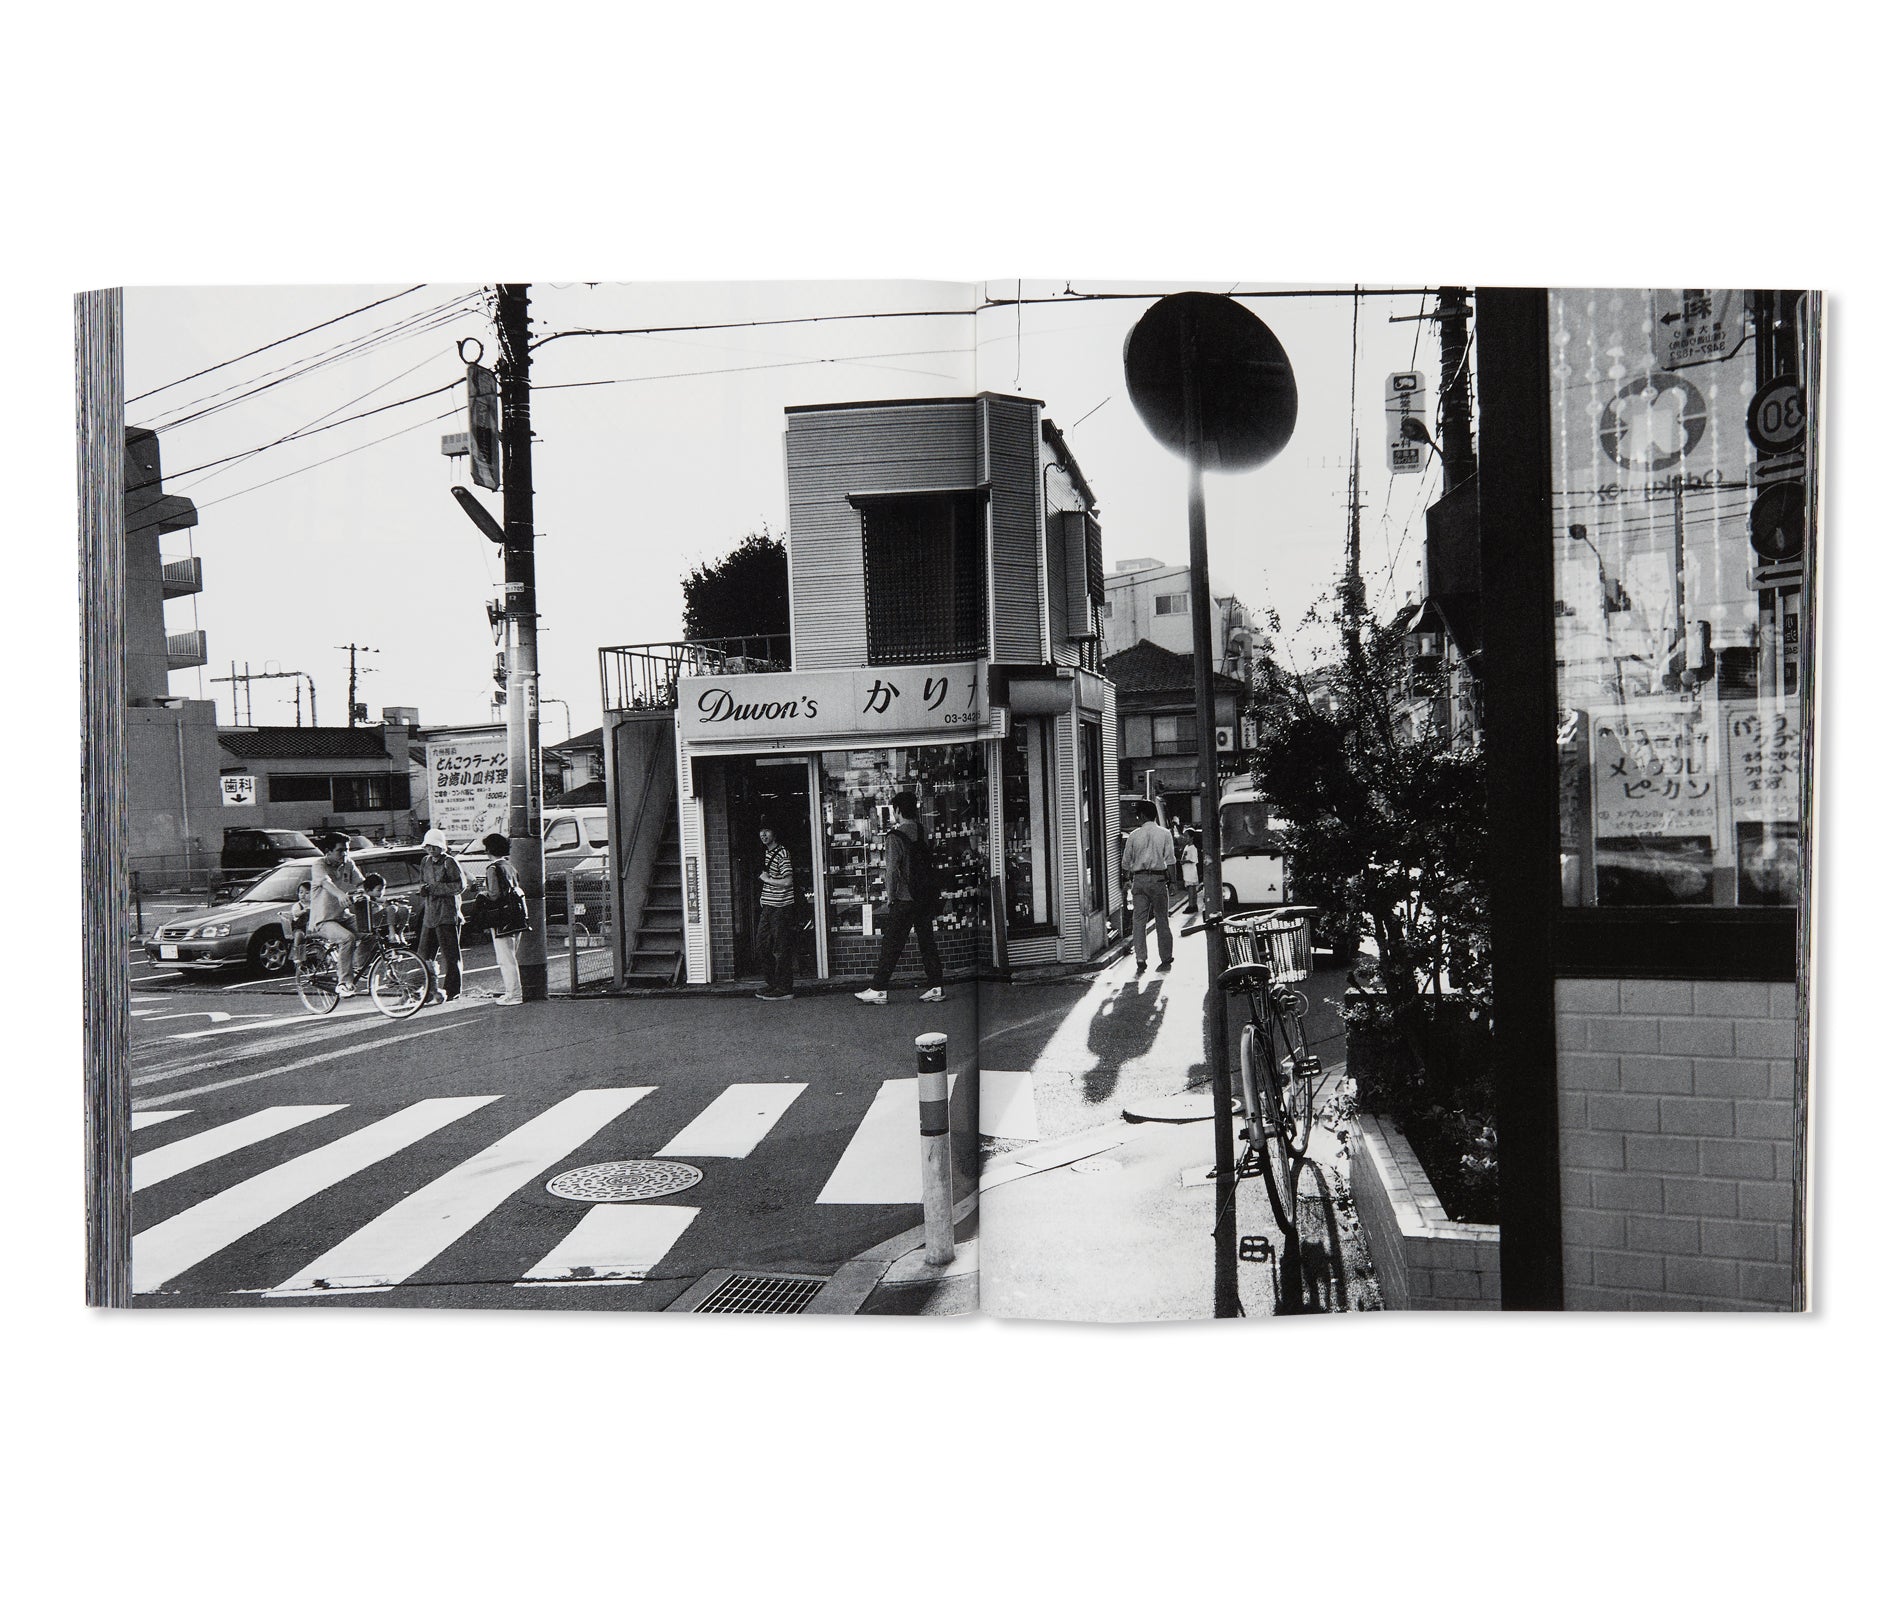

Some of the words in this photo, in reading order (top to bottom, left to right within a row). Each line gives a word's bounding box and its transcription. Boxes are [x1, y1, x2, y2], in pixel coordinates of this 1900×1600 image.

[436, 753, 507, 770] とんこつラーメン
[223, 778, 252, 793] 歯科
